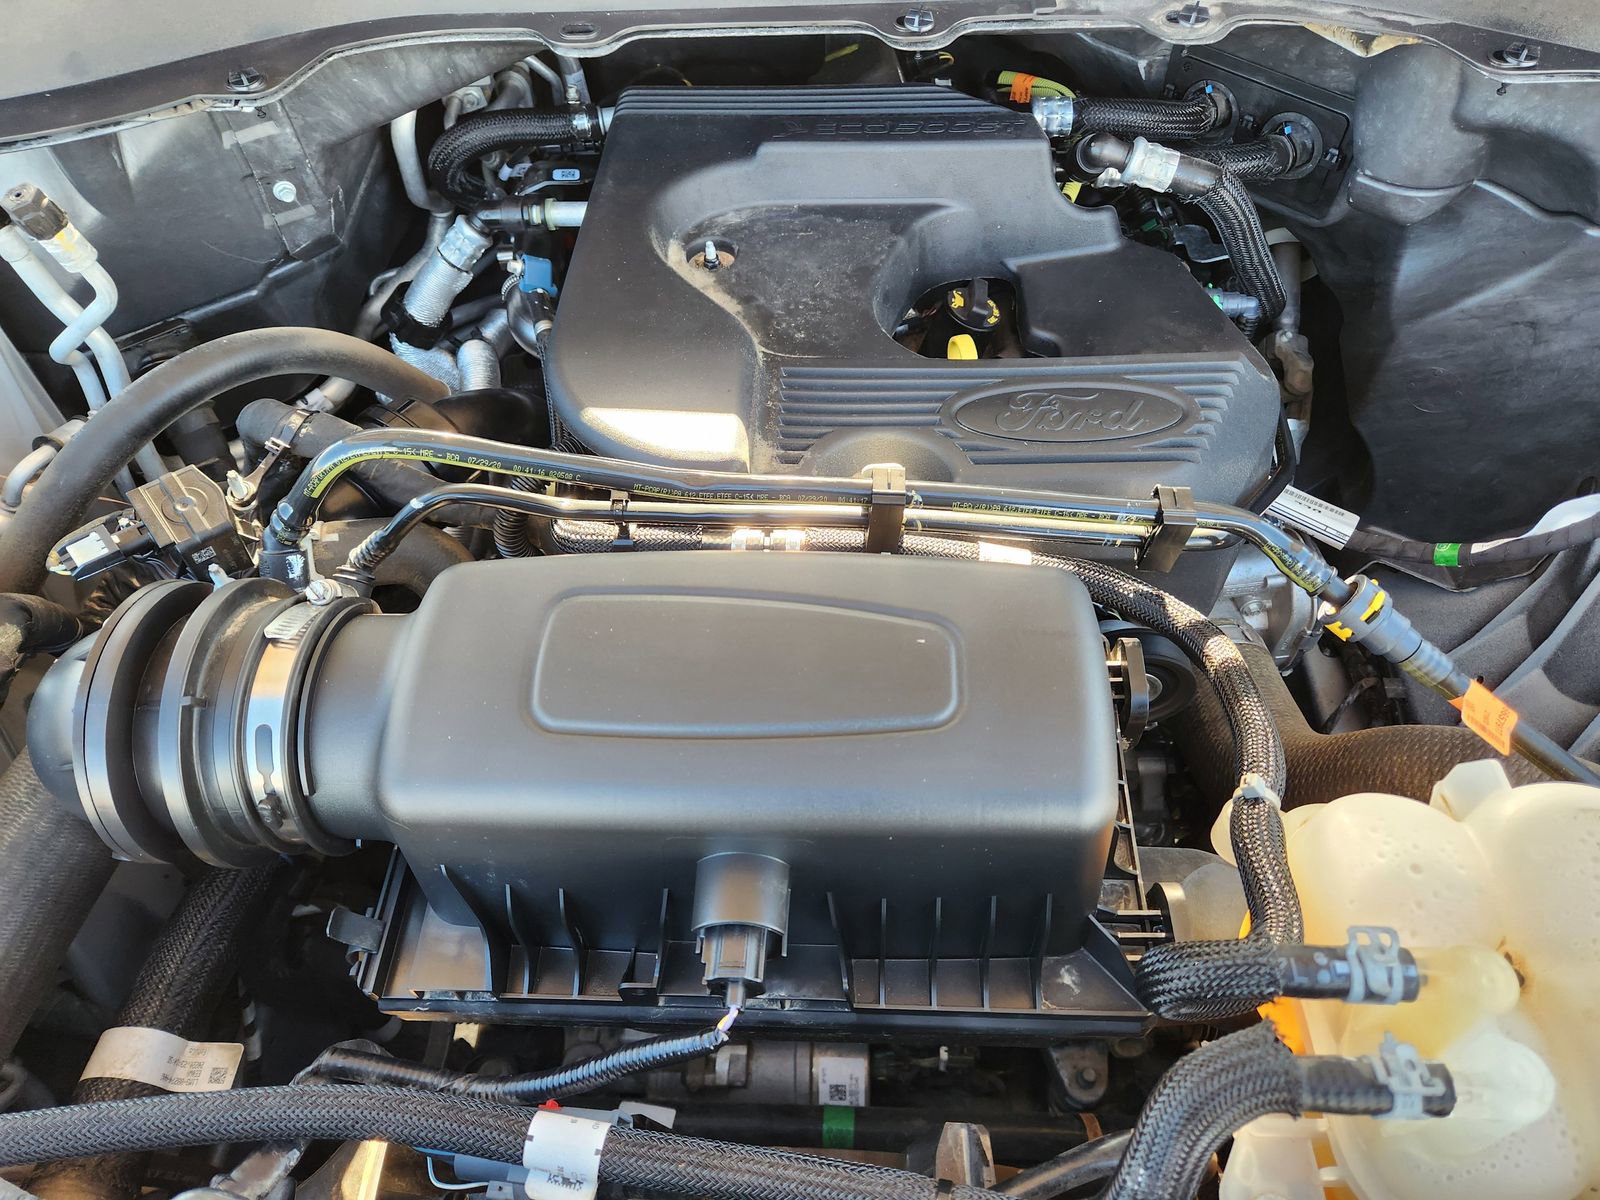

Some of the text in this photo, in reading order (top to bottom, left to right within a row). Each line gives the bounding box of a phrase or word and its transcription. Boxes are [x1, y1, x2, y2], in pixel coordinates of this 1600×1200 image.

[815, 118, 1026, 136] ECOBOOST
[995, 391, 1148, 431] Ford
[467, 456, 502, 470] 07/29/20
[512, 464, 545, 477] 00:41:16
[797, 494, 828, 503] 07/29/20
